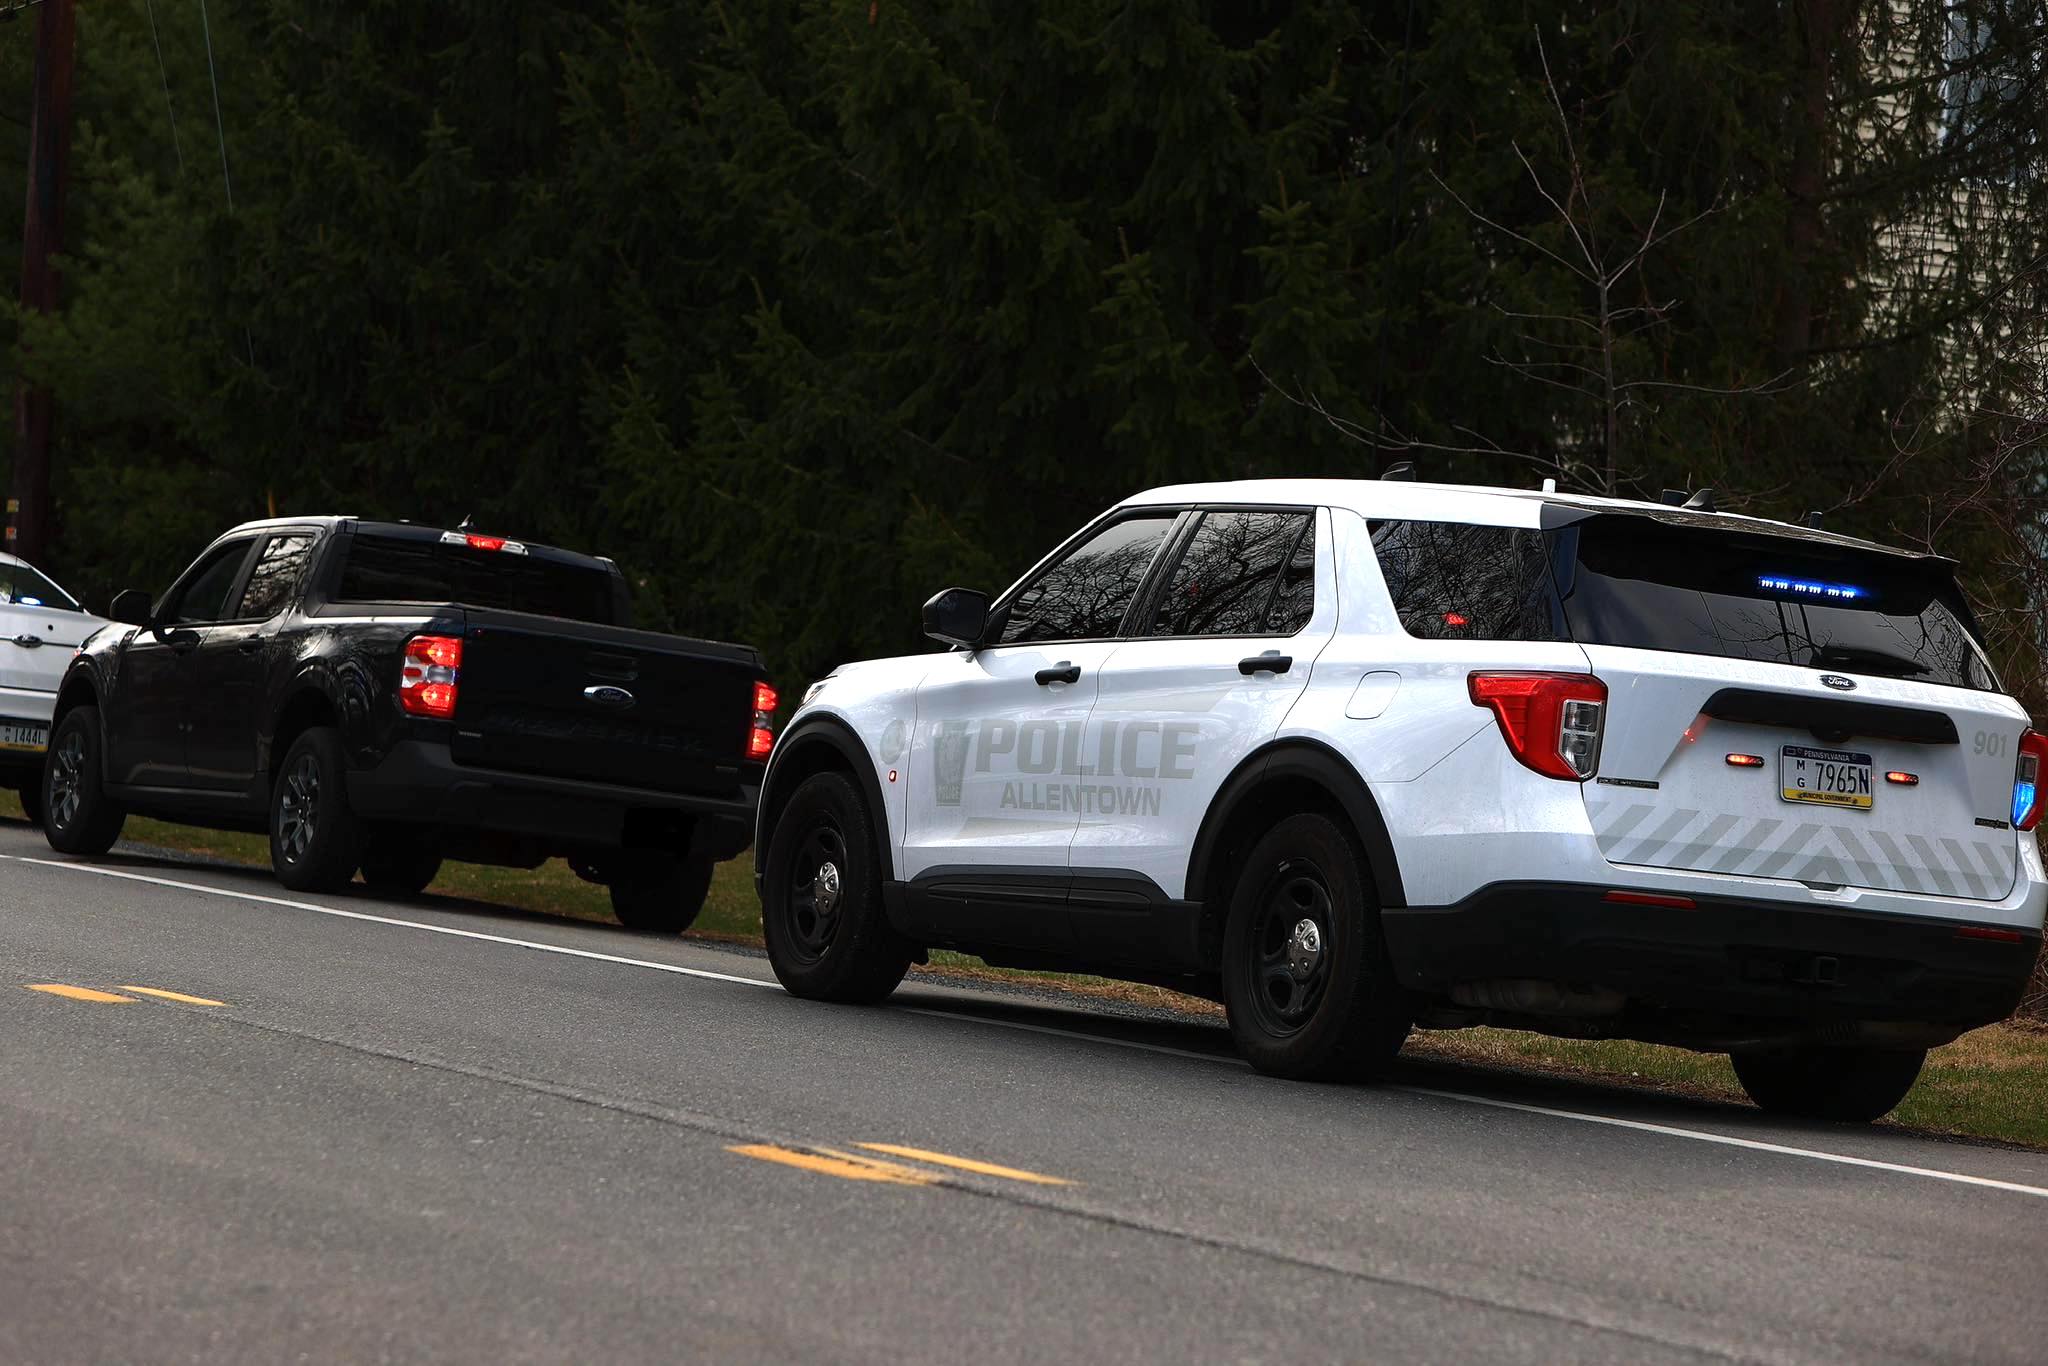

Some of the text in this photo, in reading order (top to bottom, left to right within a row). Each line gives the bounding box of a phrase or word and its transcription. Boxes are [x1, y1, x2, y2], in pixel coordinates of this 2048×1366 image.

[975, 719, 1200, 779] POLICE
[1804, 749, 1850, 761] PENNSYLVANIA
[1973, 729, 2008, 758] 901
[1797, 760, 1805, 770] M
[1815, 763, 1869, 794] 7965N
[1797, 777, 1805, 788] G
[1000, 782, 1161, 816] ALLENTOWN
